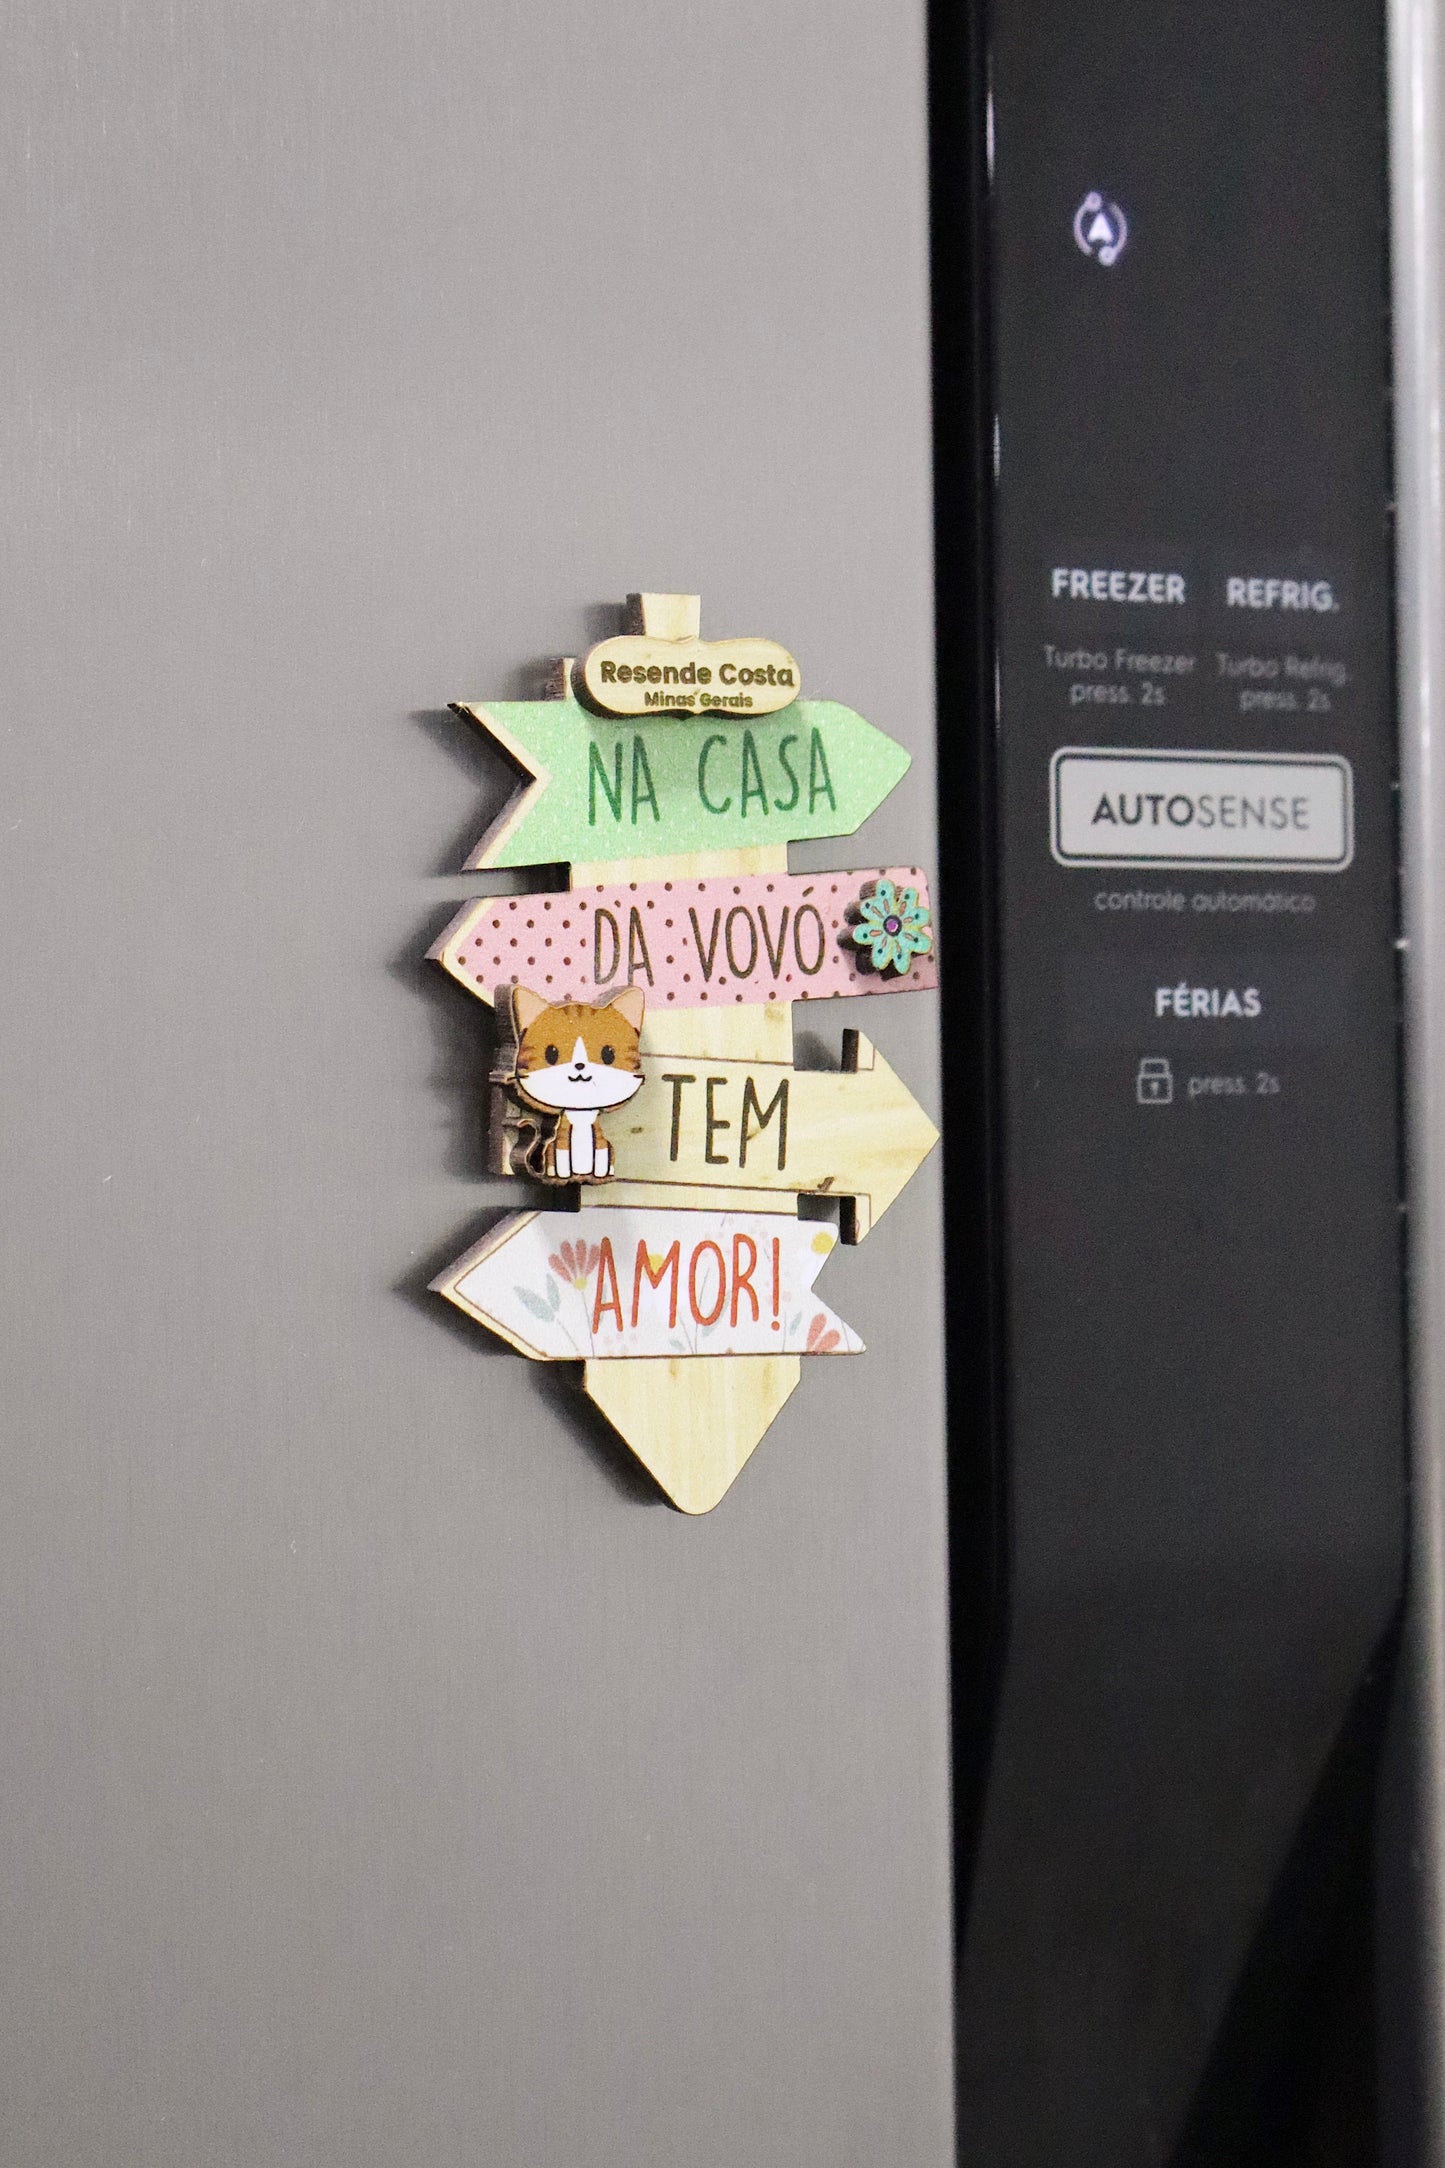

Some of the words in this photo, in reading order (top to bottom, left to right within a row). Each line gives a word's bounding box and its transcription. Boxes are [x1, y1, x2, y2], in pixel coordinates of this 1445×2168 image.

[1051, 567, 1186, 604] FREEZER
[600, 661, 712, 685] Resende
[718, 662, 795, 687] Costa
[1044, 645, 1108, 670] Turbo
[1114, 649, 1196, 675] Freezer
[1215, 653, 1280, 679] Turbo
[644, 691, 695, 707] Minas
[699, 692, 753, 708] Gerais
[1141, 681, 1166, 706] 2s
[588, 735, 661, 826] NA
[697, 727, 837, 818] CASA
[1091, 793, 1311, 831] AUTOSENSE
[1094, 890, 1186, 911] controle
[594, 906, 655, 987] DA
[688, 886, 826, 983] VOVÓ
[1154, 980, 1262, 1018] FÉRIAS
[1255, 1071, 1281, 1095] 2s
[661, 1074, 790, 1171] TEM
[591, 1232, 781, 1334] AMOR!
